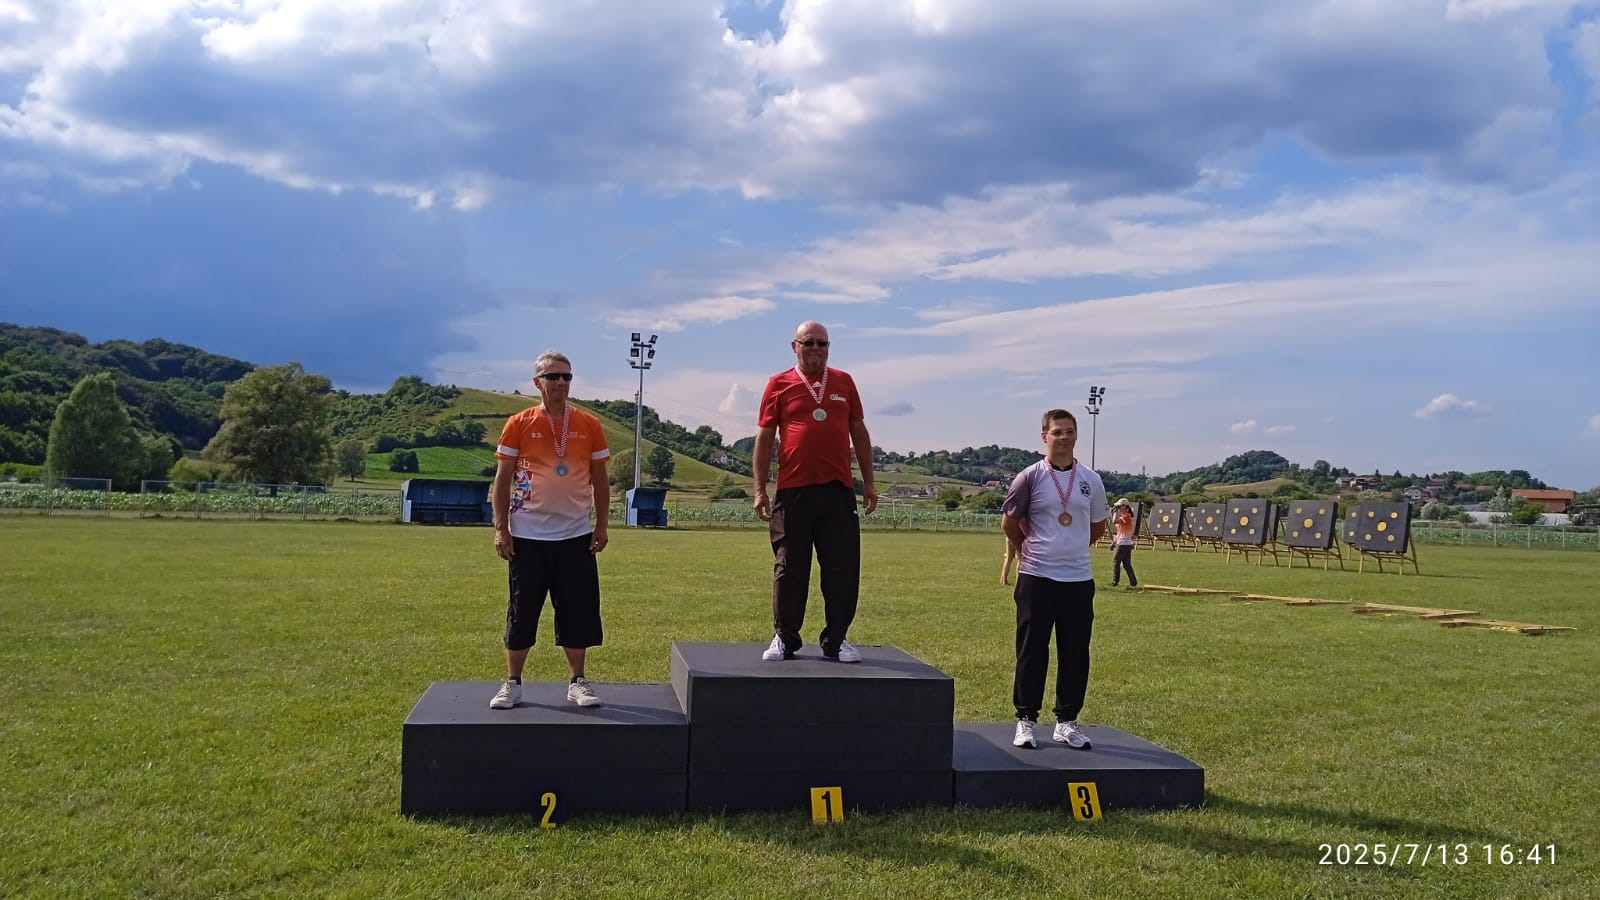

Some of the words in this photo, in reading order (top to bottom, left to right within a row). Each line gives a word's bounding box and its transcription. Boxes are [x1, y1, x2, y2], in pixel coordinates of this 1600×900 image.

[540, 792, 557, 828] 2
[821, 791, 833, 823] 1
[1077, 786, 1094, 819] 3
